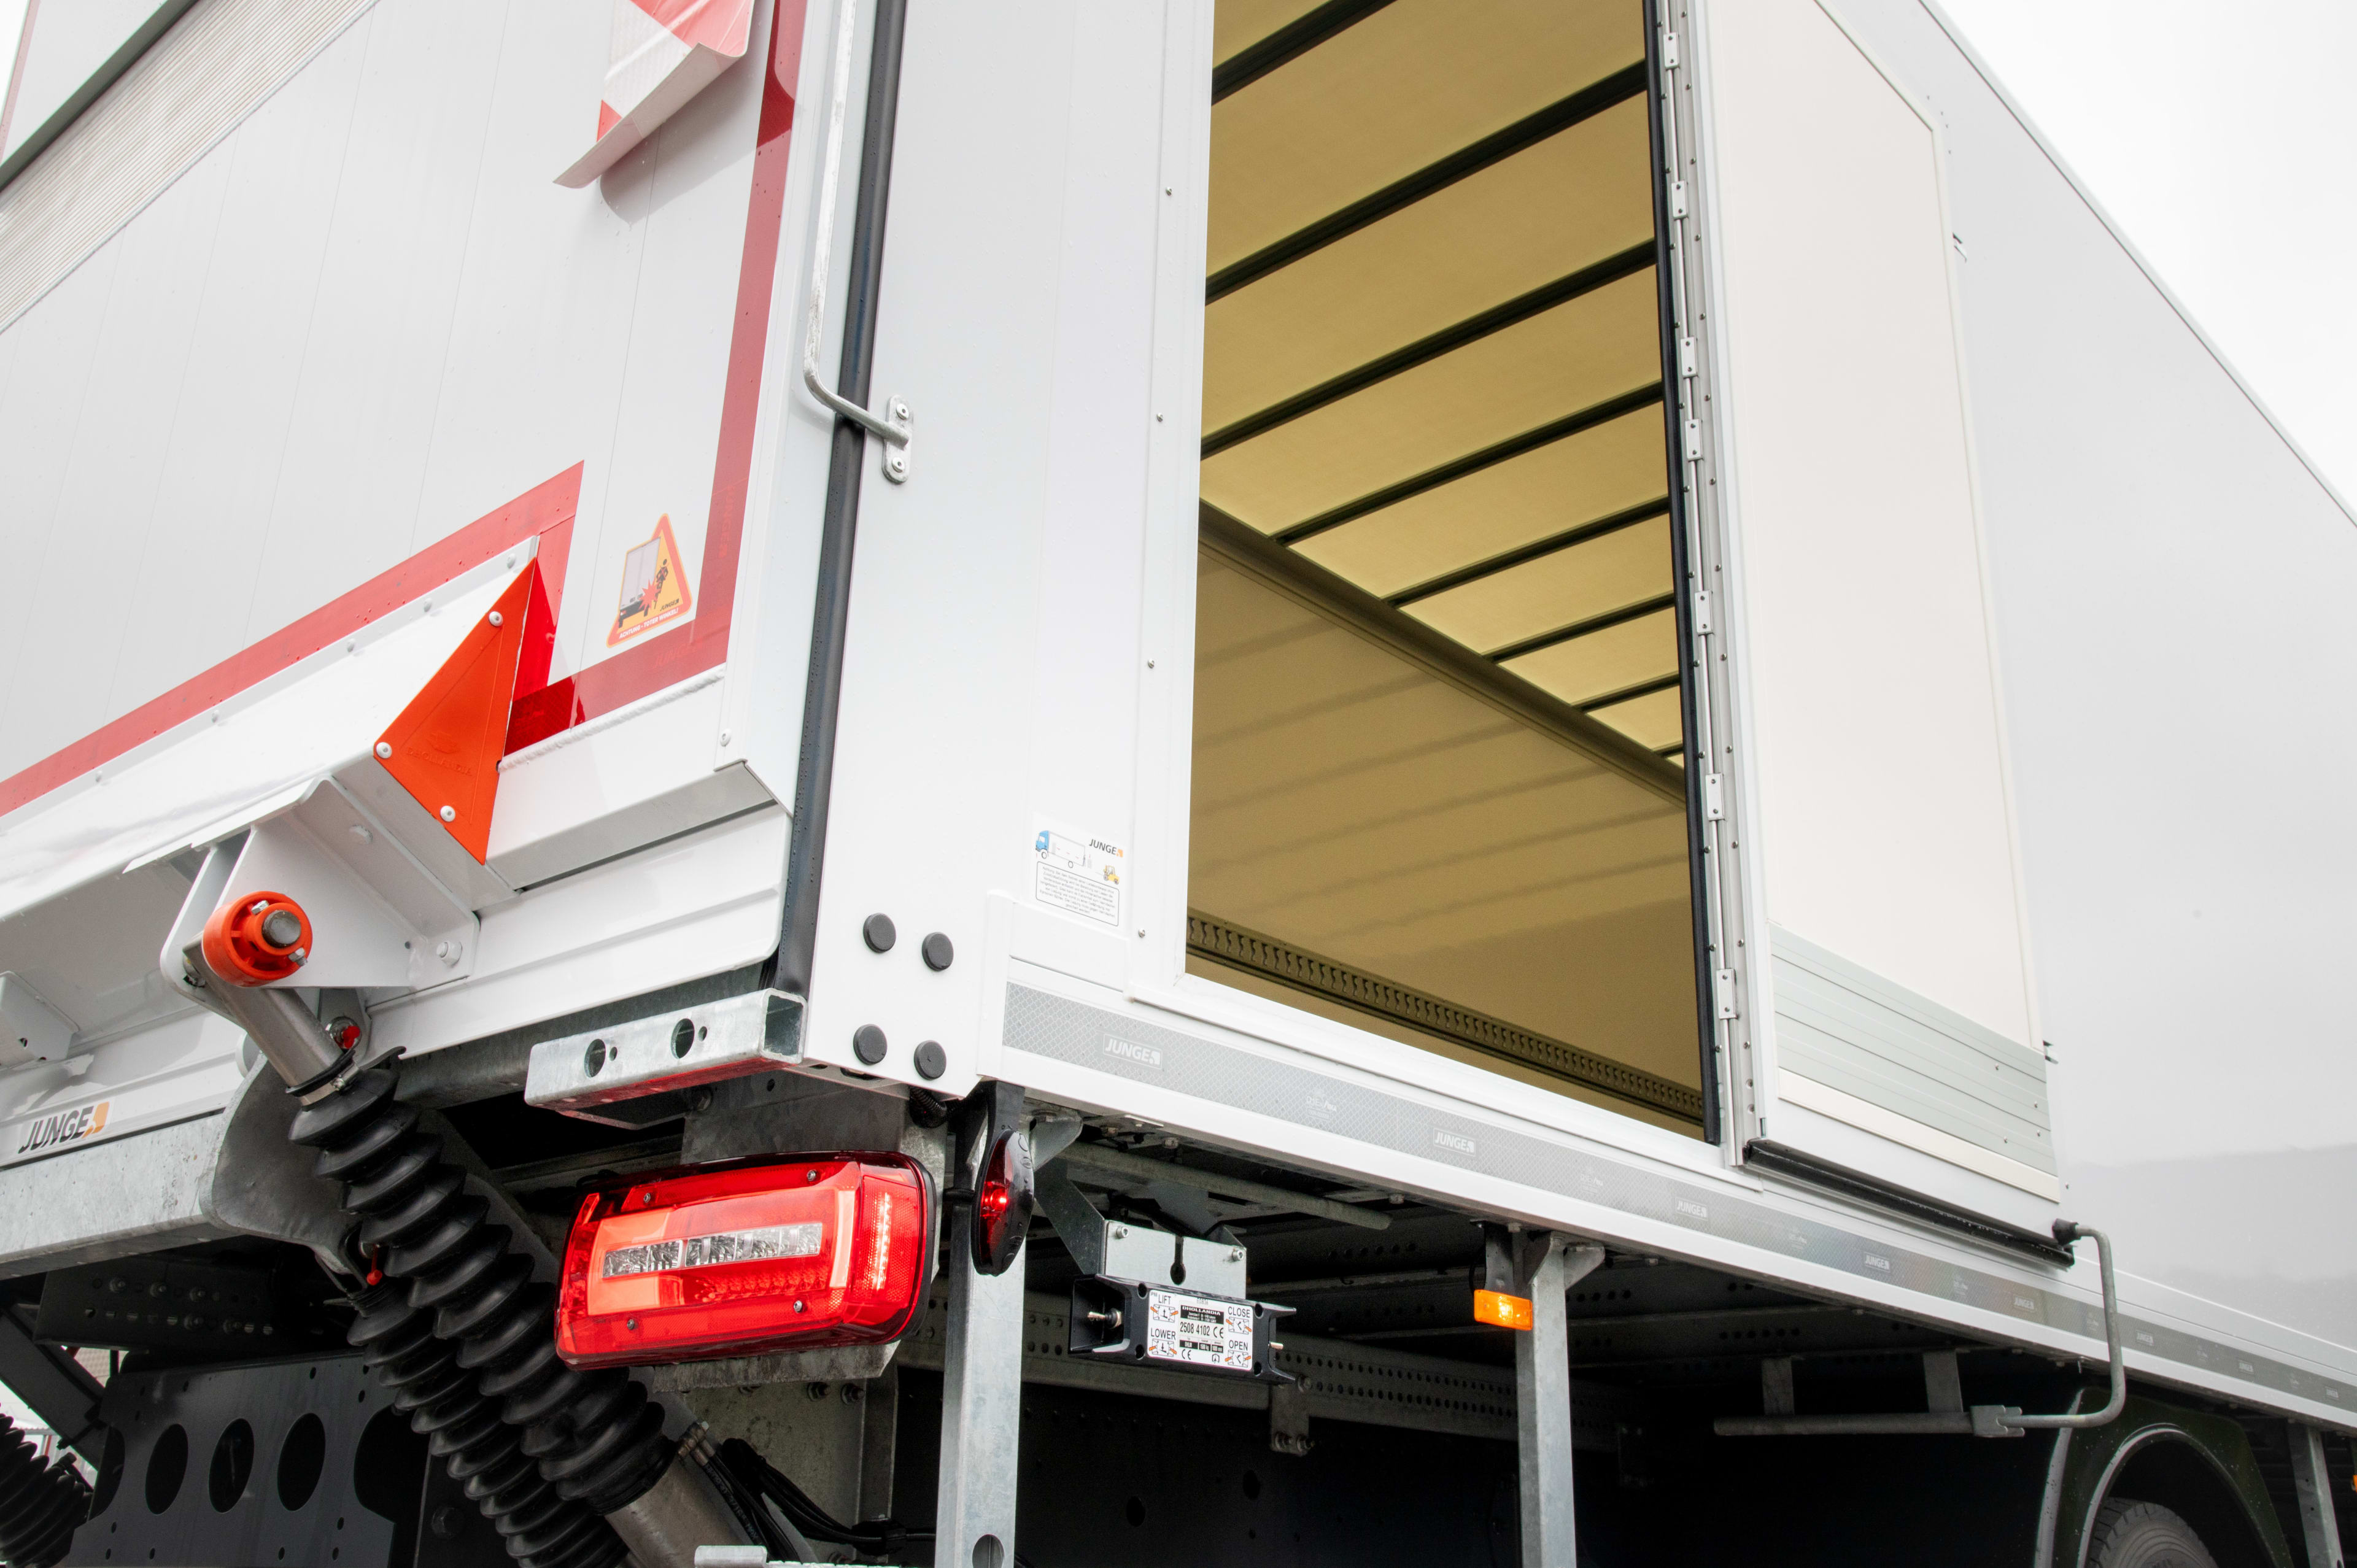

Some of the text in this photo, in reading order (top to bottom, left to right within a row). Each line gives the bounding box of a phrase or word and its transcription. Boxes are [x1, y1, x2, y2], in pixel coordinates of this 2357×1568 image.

[660, 600, 676, 611] JUNGE
[619, 624, 641, 639] ACHTUNG
[644, 616, 659, 628] TOTER
[659, 608, 679, 621] WINKEL!
[1089, 839, 1117, 855] JUNGE
[1105, 1038, 1150, 1062] JUNGE
[18, 1105, 94, 1154] JUNGE
[1435, 1132, 1467, 1151] JUNGE
[1677, 1200, 1701, 1216] JUNGE
[1158, 1296, 1171, 1305] LIFT
[1182, 1306, 1221, 1316] DHOLLANDIA
[1228, 1306, 1250, 1318] CLOSE
[1151, 1328, 1176, 1340] LOWER
[1180, 1321, 1210, 1336] 2508 4102
[1229, 1340, 1248, 1351] OPEN
[1182, 1349, 1192, 1361] CE
